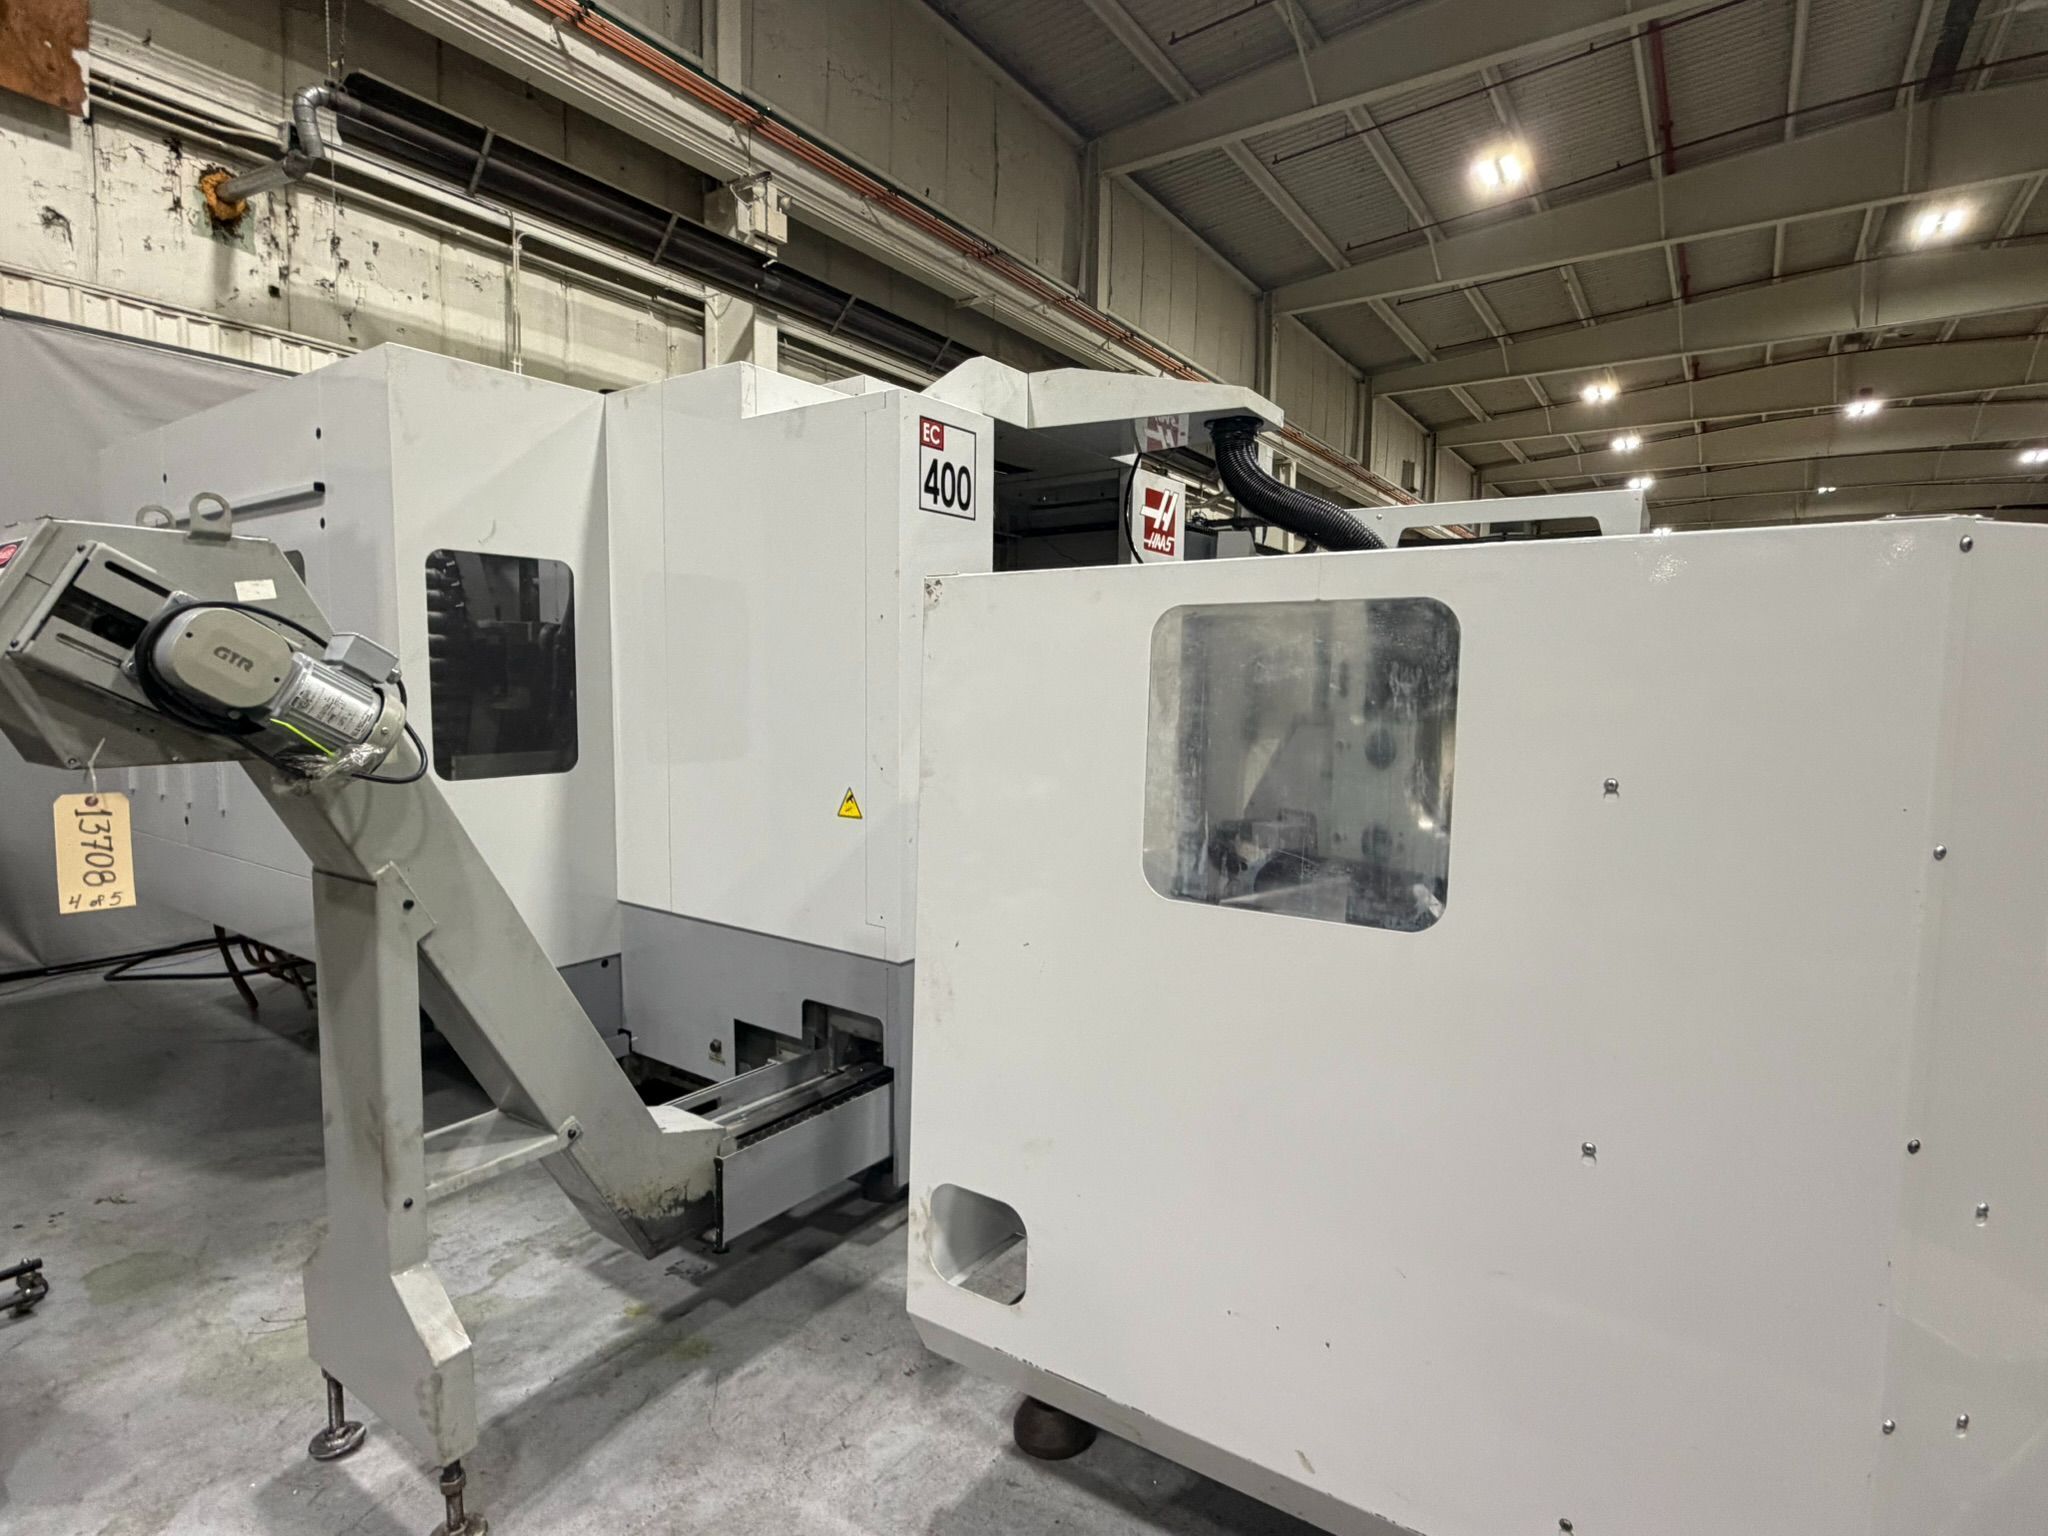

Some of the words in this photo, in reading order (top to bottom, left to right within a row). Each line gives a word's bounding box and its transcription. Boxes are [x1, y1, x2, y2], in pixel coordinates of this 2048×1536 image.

[923, 422, 940, 445] EC
[924, 458, 971, 511] 400
[1144, 532, 1176, 553] HAAS
[213, 646, 254, 673] GTR
[75, 808, 116, 887] 13708
[69, 894, 82, 909] 4
[89, 895, 105, 907] of
[109, 892, 123, 906] 5
